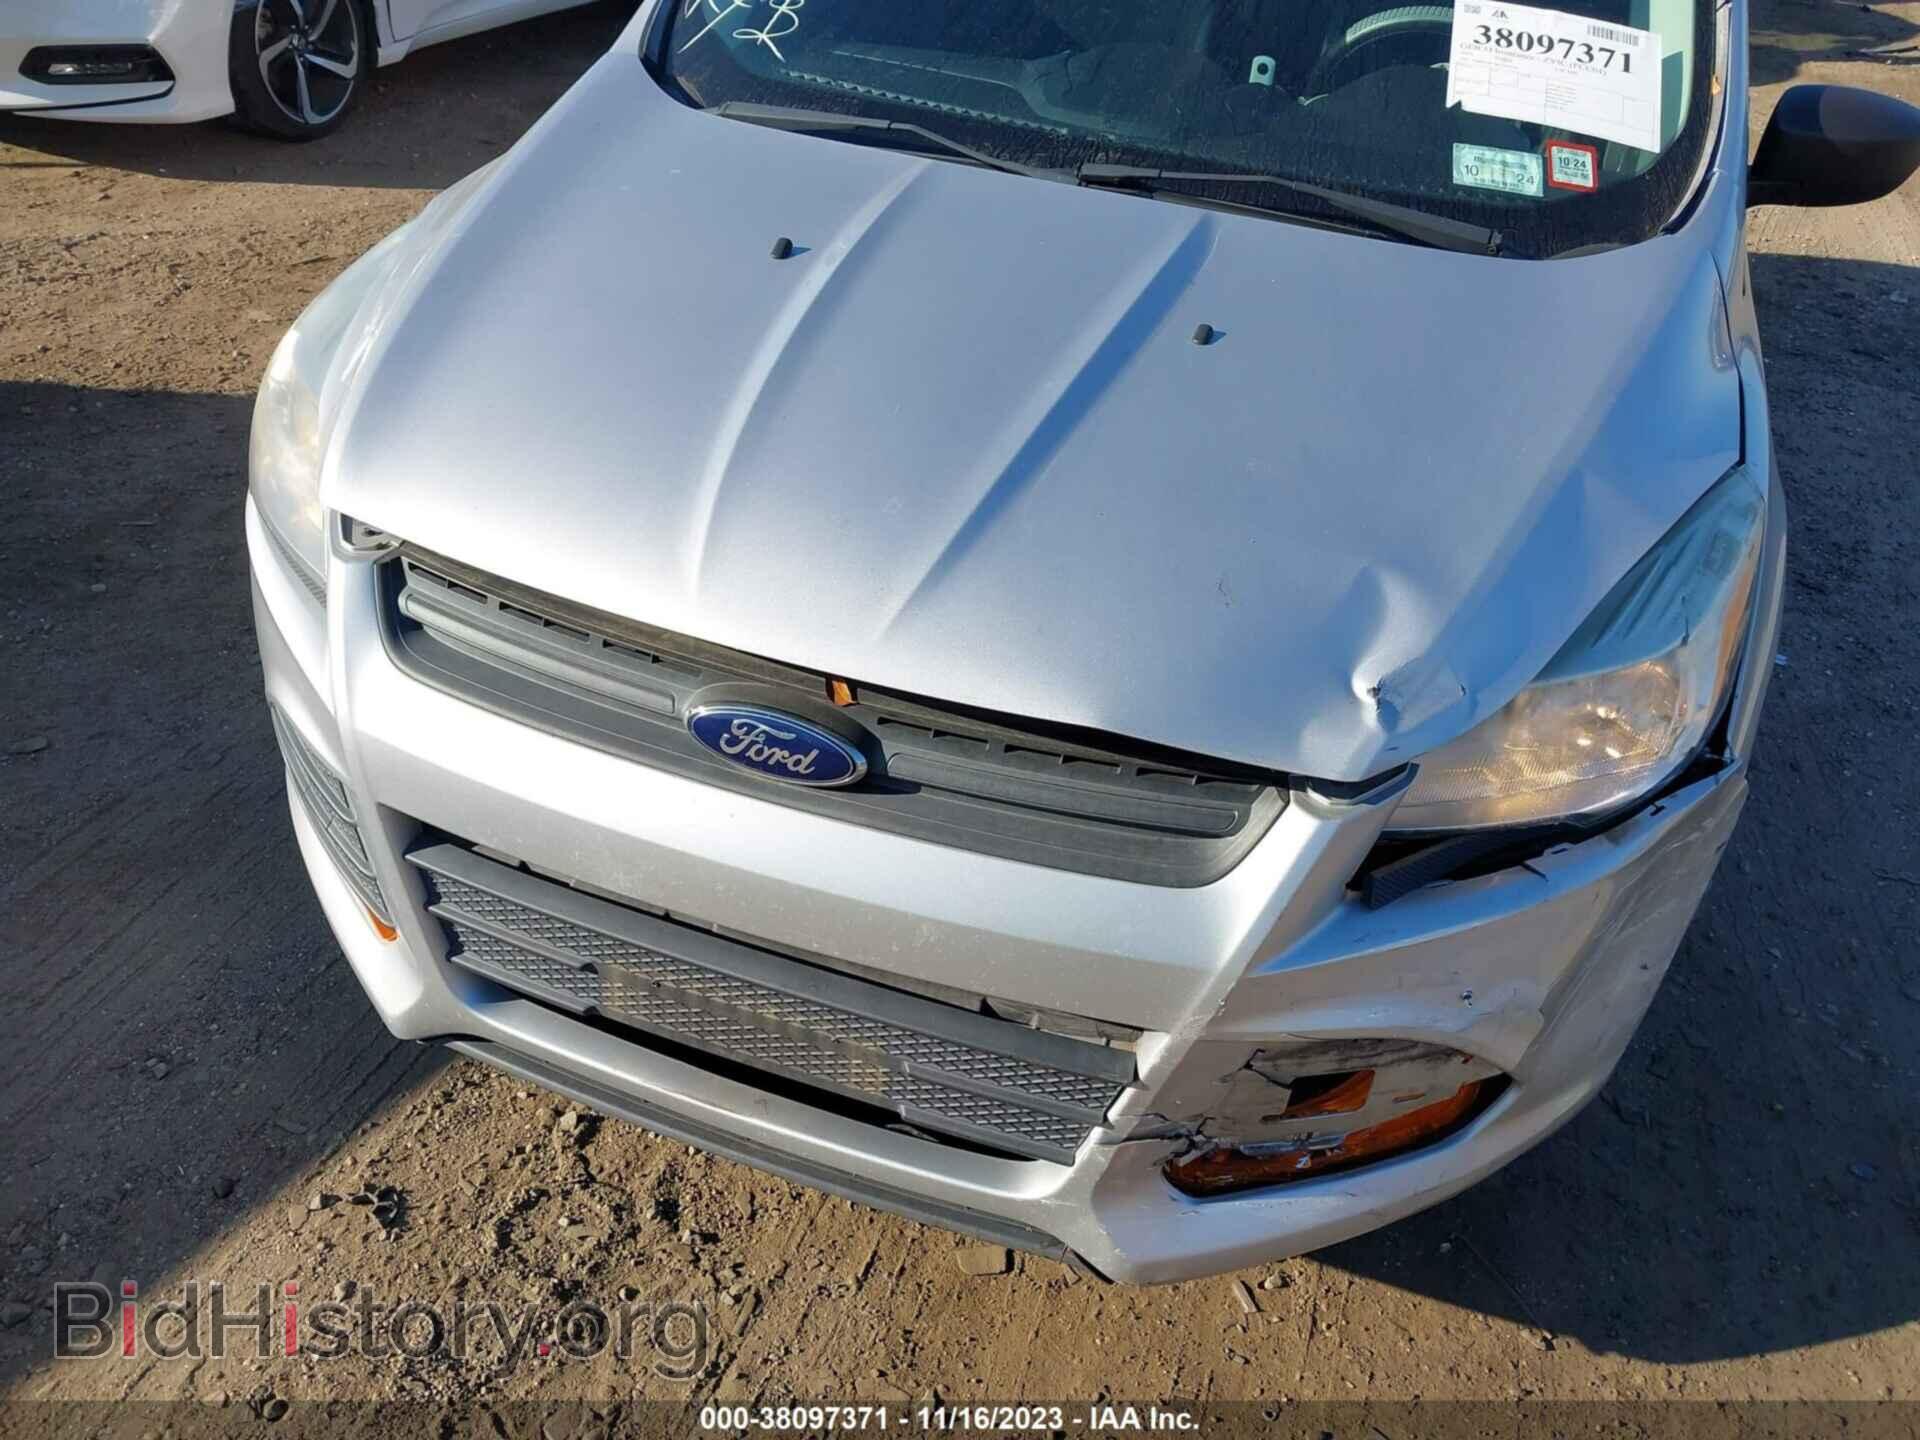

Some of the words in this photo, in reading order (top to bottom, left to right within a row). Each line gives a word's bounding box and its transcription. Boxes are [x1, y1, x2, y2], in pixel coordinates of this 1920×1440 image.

[1472, 24, 1633, 74] 38097371
[1464, 164, 1480, 177] 10
[1515, 173, 1536, 186] 24
[720, 718, 820, 775] Ford
